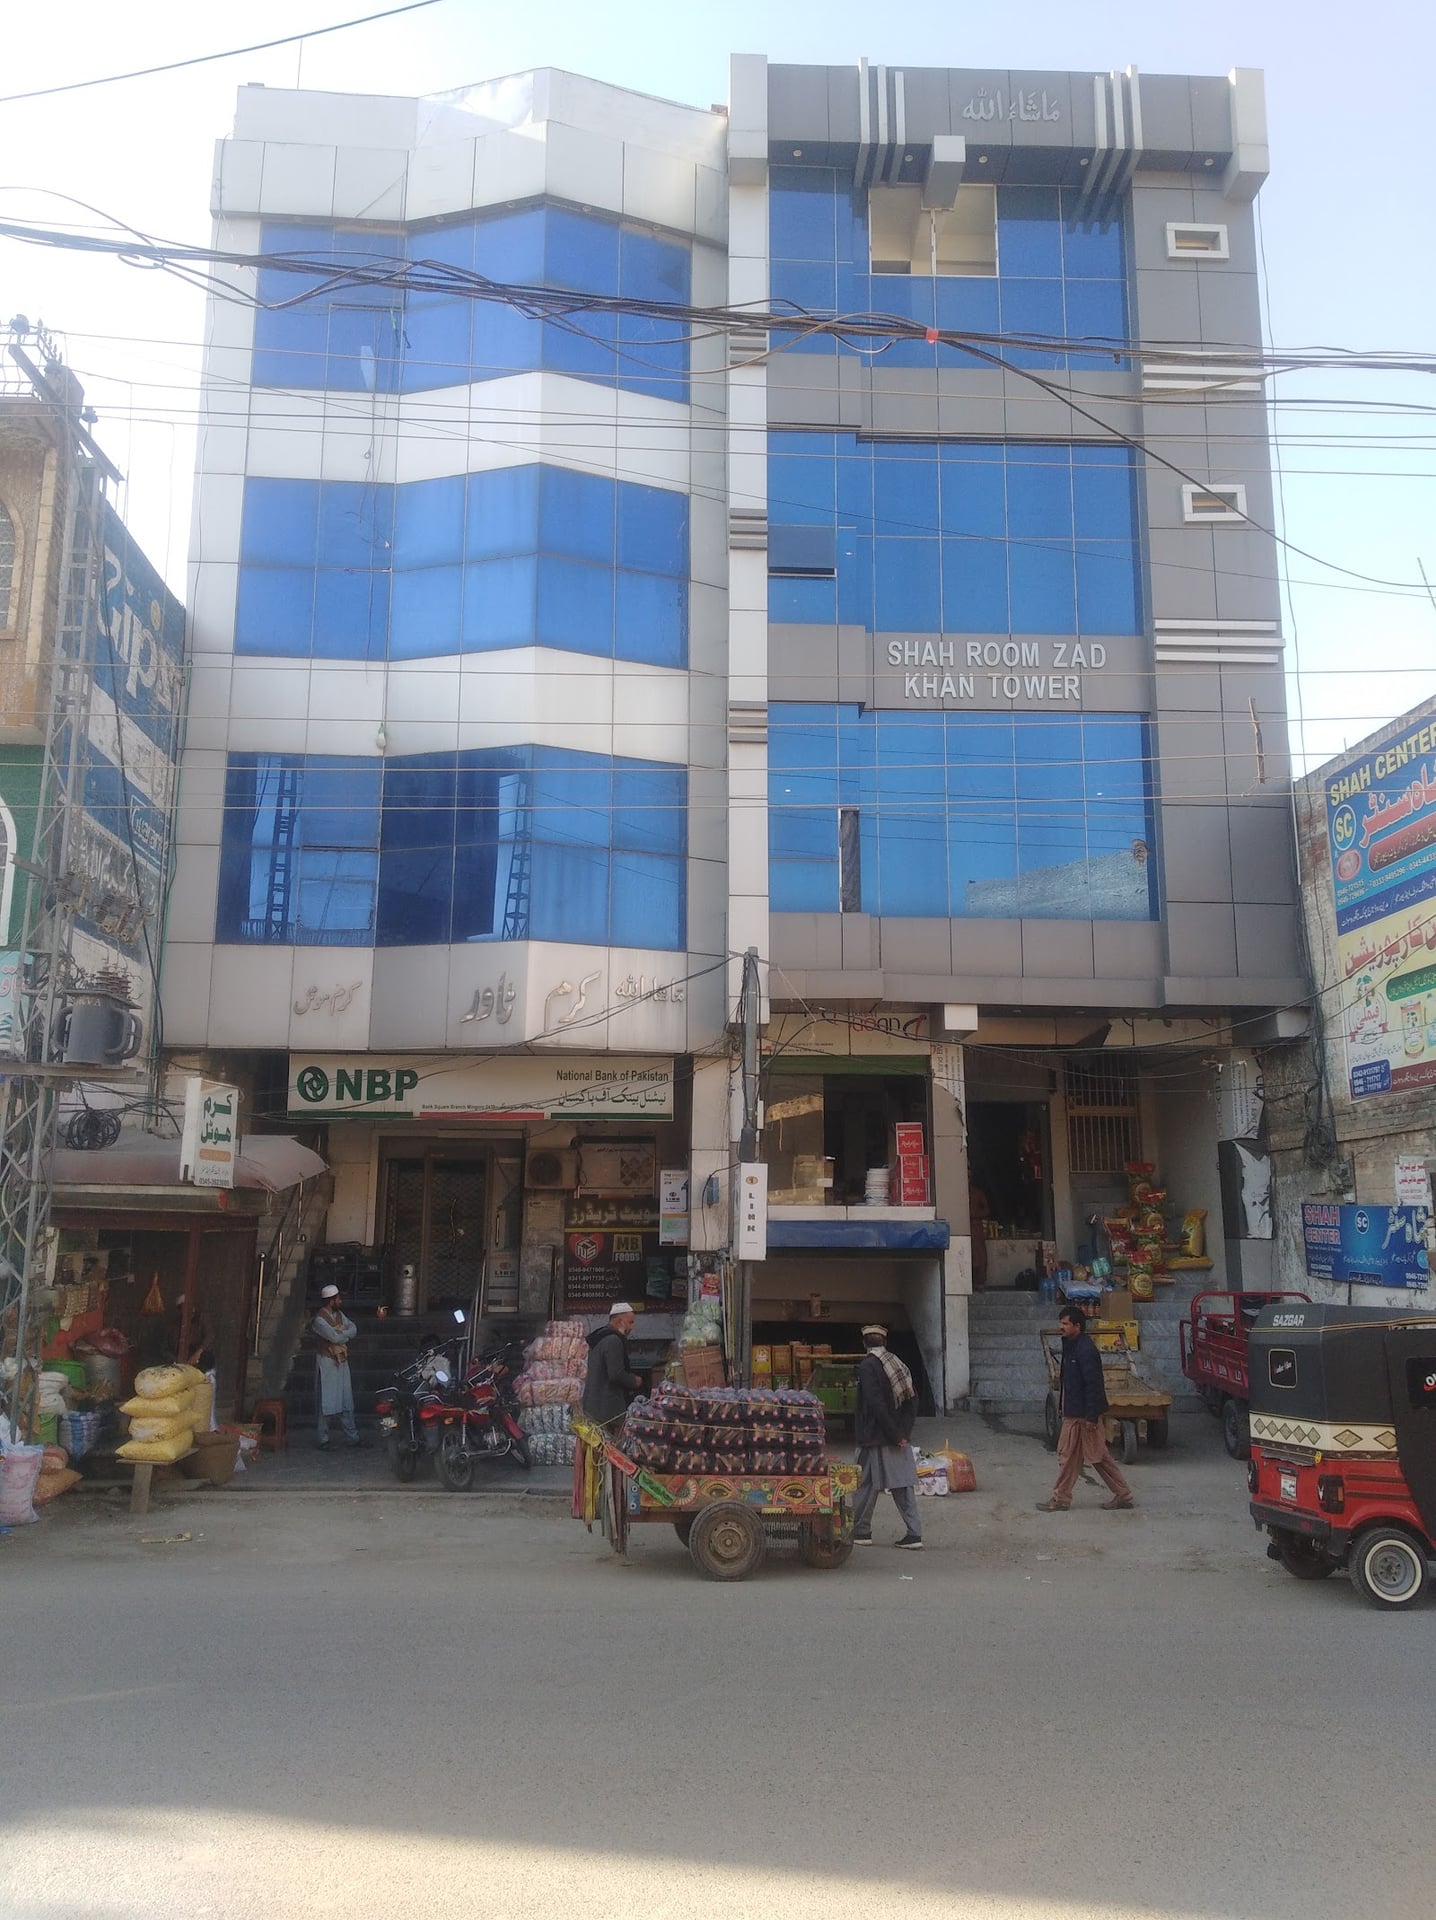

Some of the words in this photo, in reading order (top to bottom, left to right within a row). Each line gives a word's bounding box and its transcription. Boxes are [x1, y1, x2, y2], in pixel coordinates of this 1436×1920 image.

[888, 641, 954, 666] SHAH
[966, 641, 1040, 667] ROOM
[1053, 643, 1107, 668] ZAD
[904, 672, 975, 698] KHAN
[988, 673, 1081, 699] TOWER
[1330, 763, 1372, 806] SHAH
[1336, 812, 1353, 842] SC
[459, 971, 516, 1024] ٹاور
[543, 970, 601, 1032] کرم
[335, 1069, 418, 1101] NBP
[556, 1069, 593, 1082] National
[595, 1069, 618, 1082] Bank
[620, 1069, 630, 1081] of
[630, 1069, 669, 1082] Pakistan
[558, 1088, 595, 1107] پاکستان
[595, 1087, 611, 1102] آف
[612, 1086, 639, 1106] بینک
[639, 1091, 666, 1108] نیشنل
[204, 1093, 233, 1119] کرم
[1304, 1205, 1340, 1226] SHAH
[1357, 1217, 1367, 1228] SC
[617, 1235, 639, 1251] MB
[1305, 1227, 1341, 1245] CENTER
[615, 1252, 640, 1261] FOODS
[1273, 1315, 1305, 1327] SAZGAR
